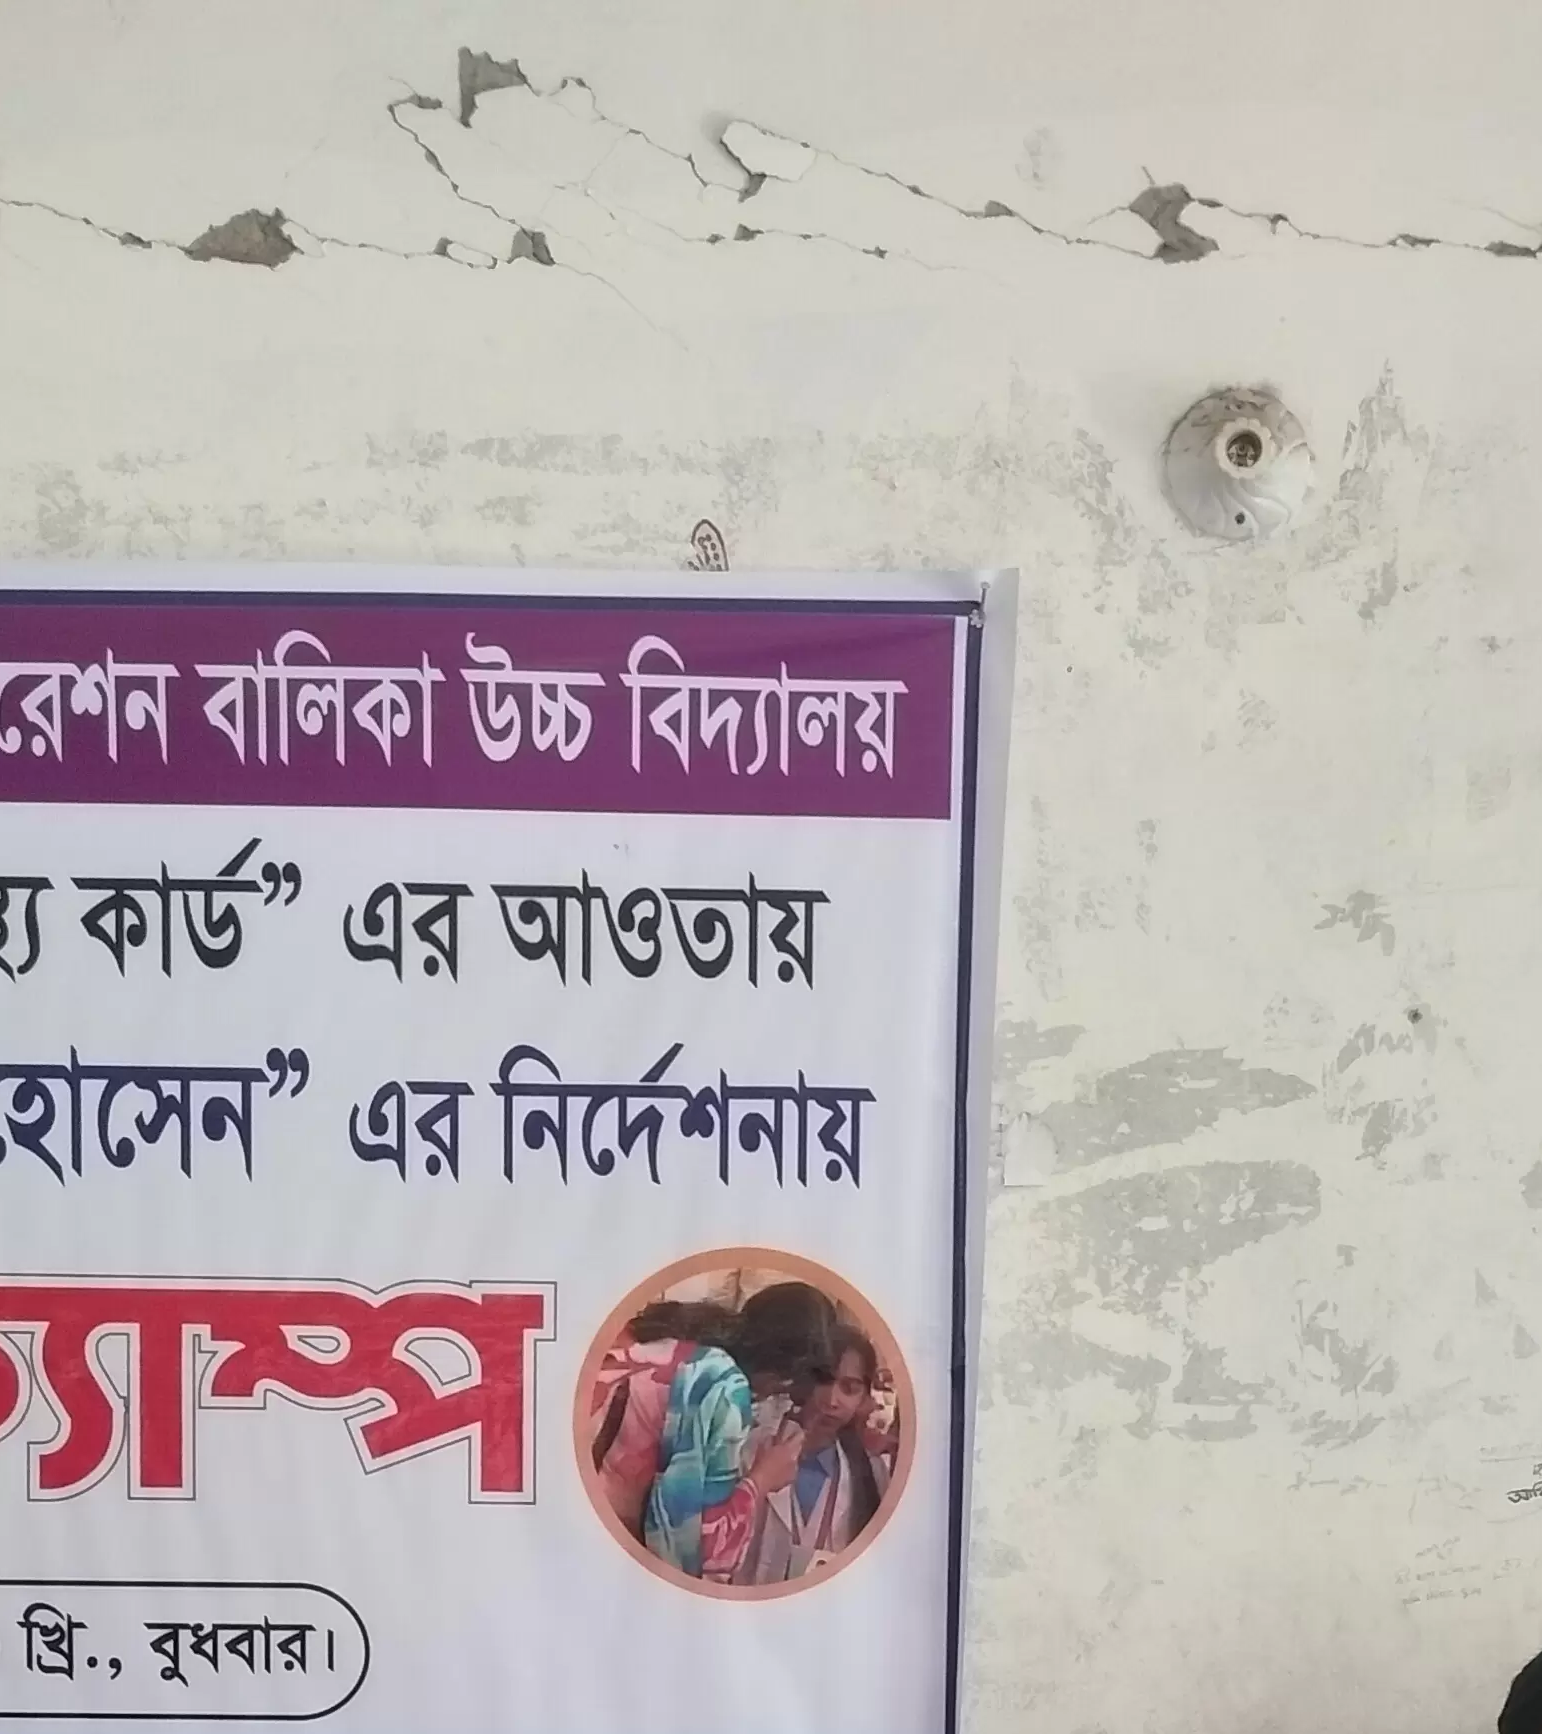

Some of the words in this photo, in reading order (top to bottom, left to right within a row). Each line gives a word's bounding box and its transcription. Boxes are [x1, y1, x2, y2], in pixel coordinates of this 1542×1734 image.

[194, 630, 446, 767] বালিকা
[460, 633, 605, 761] উচ্চ
[619, 636, 908, 778] বিদ্যালয়
[343, 883, 474, 983] এর
[491, 869, 830, 990] আওতায়
[349, 1081, 474, 1183] এর
[489, 1043, 876, 1188] নির্দেশনায়
